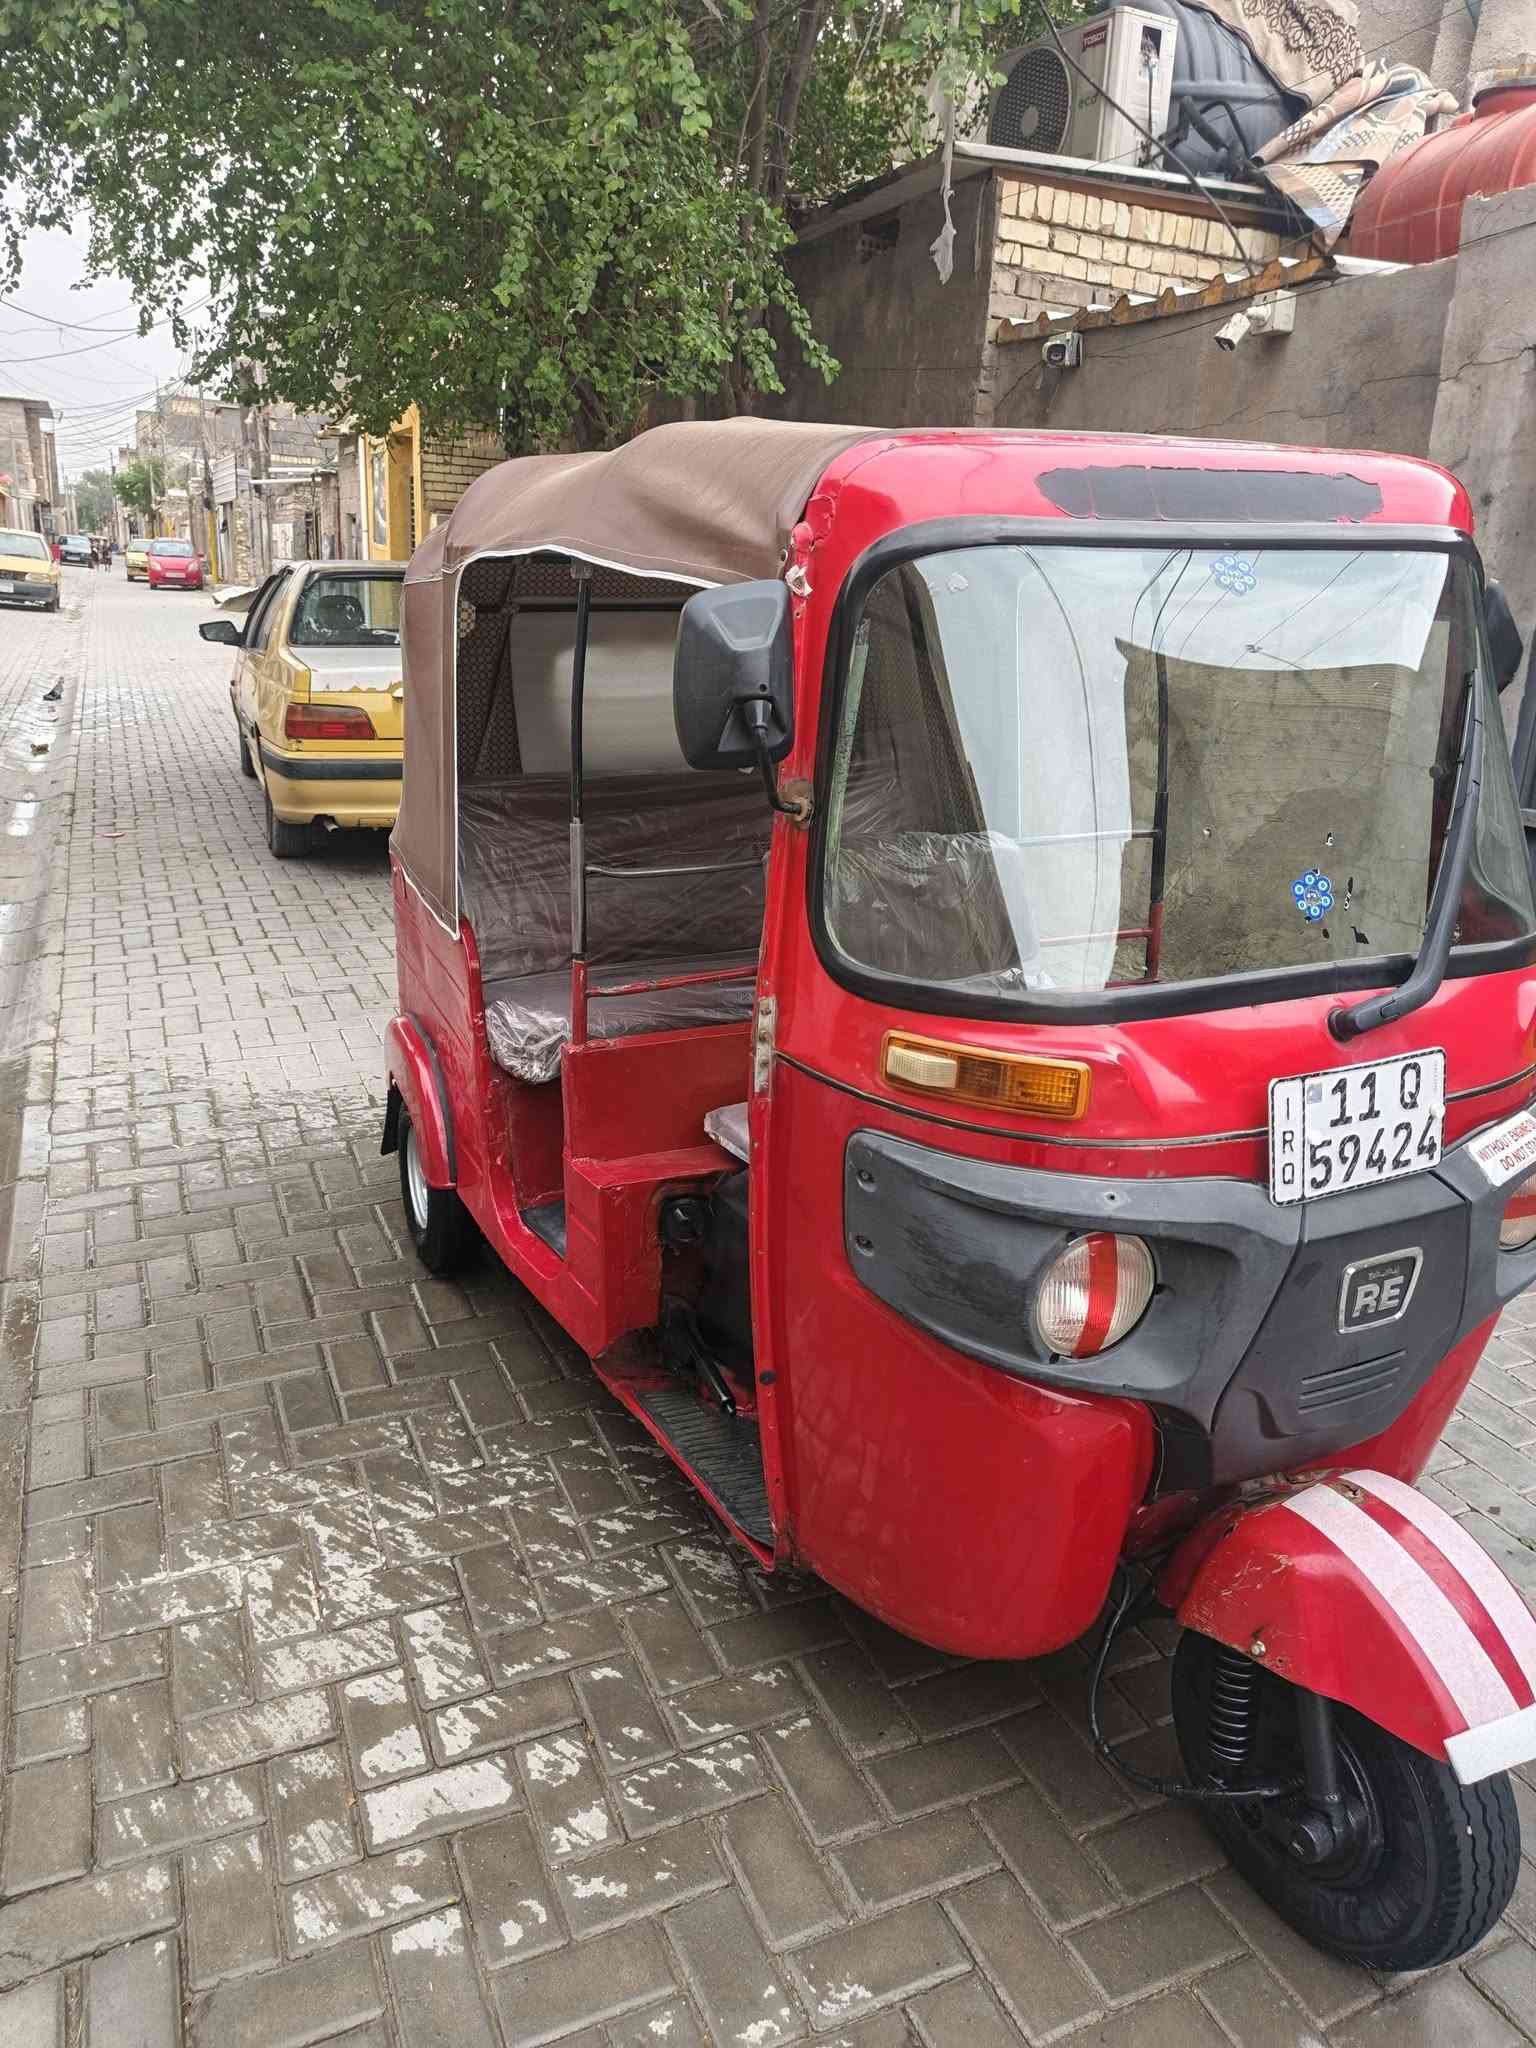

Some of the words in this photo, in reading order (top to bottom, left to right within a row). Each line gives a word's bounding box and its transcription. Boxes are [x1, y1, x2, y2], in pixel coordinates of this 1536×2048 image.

[1330, 1071, 1381, 1128] 11
[1400, 1062, 1422, 1110] Q
[1282, 1097, 1295, 1185] IRQ
[1309, 1114, 1437, 1190] 59424
[1479, 1134, 1512, 1161] WITHOUT
[1500, 1154, 1515, 1170] DO
[1512, 1145, 1529, 1161] NOT
[1352, 1275, 1404, 1318] RE
